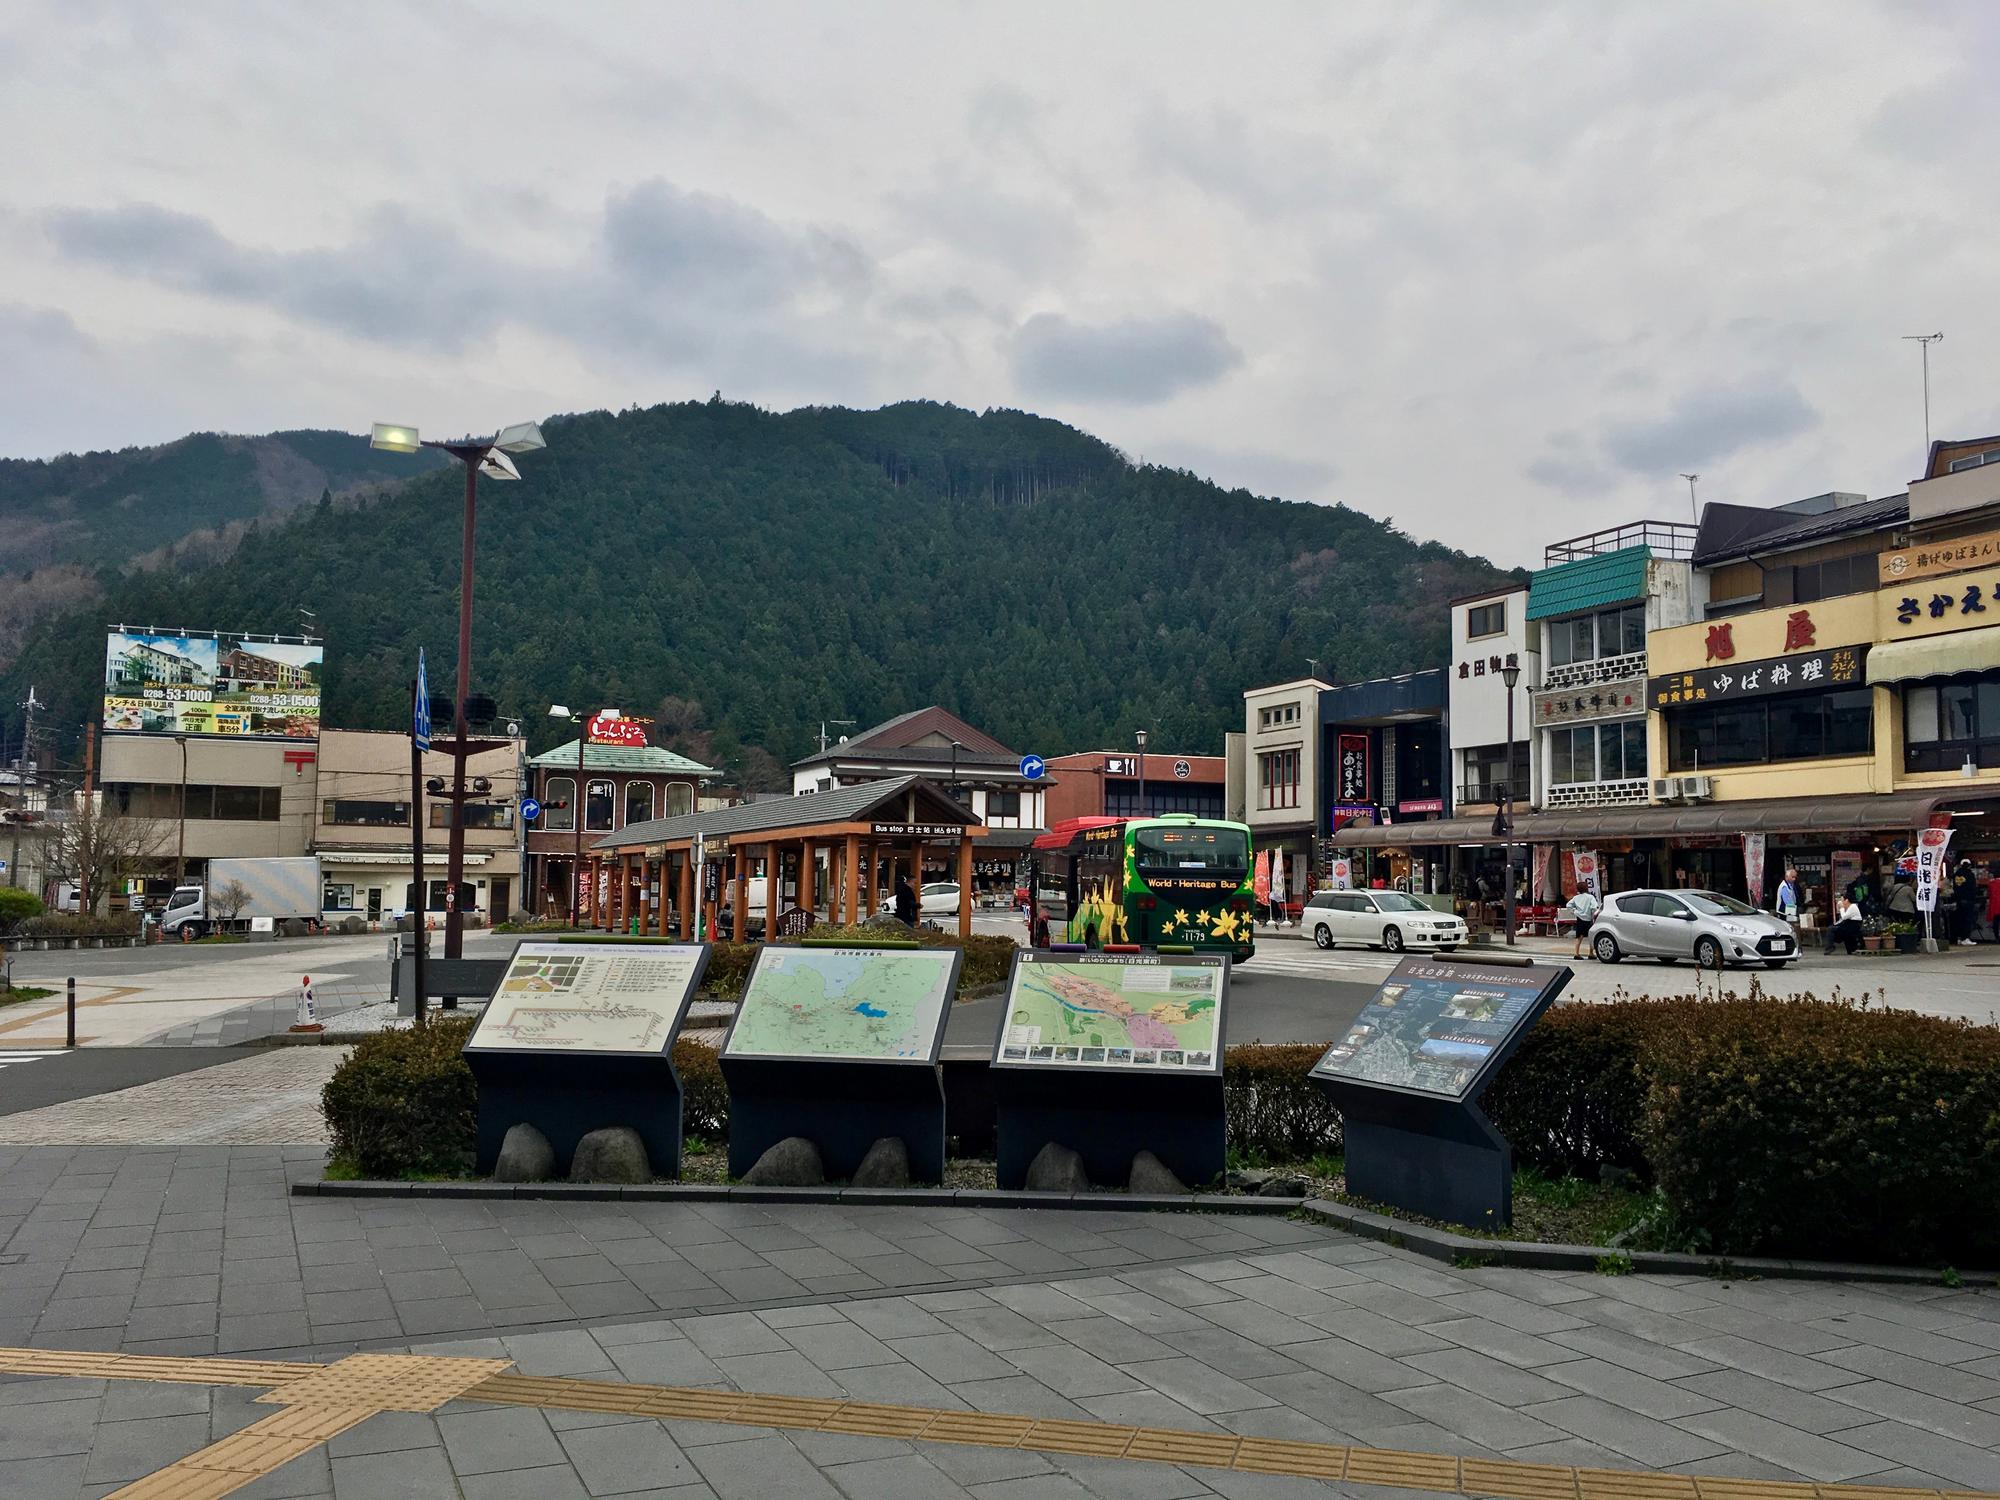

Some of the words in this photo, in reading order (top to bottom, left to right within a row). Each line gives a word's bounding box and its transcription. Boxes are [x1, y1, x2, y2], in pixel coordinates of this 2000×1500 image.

[1705, 610, 1817, 662] 旭屋
[1830, 658, 1857, 671] うどん
[1713, 658, 1824, 694] ゆば料理
[1832, 668, 1852, 681] そば
[1670, 675, 1694, 689] 二階
[144, 689, 212, 702] 0288-53-1000
[250, 694, 319, 707] 0288-53-0500
[1658, 688, 1707, 705] 御食事処
[185, 723, 202, 731] 正面
[218, 725, 240, 733] 車5分
[1343, 751, 1356, 798] あずま
[1355, 752, 1363, 788] お食事処
[889, 825, 904, 833] stop
[907, 826, 930, 834] 巴士站
[1148, 879, 1172, 887] World
[1178, 880, 1216, 889] Heritage
[1220, 880, 1237, 889] Bus
